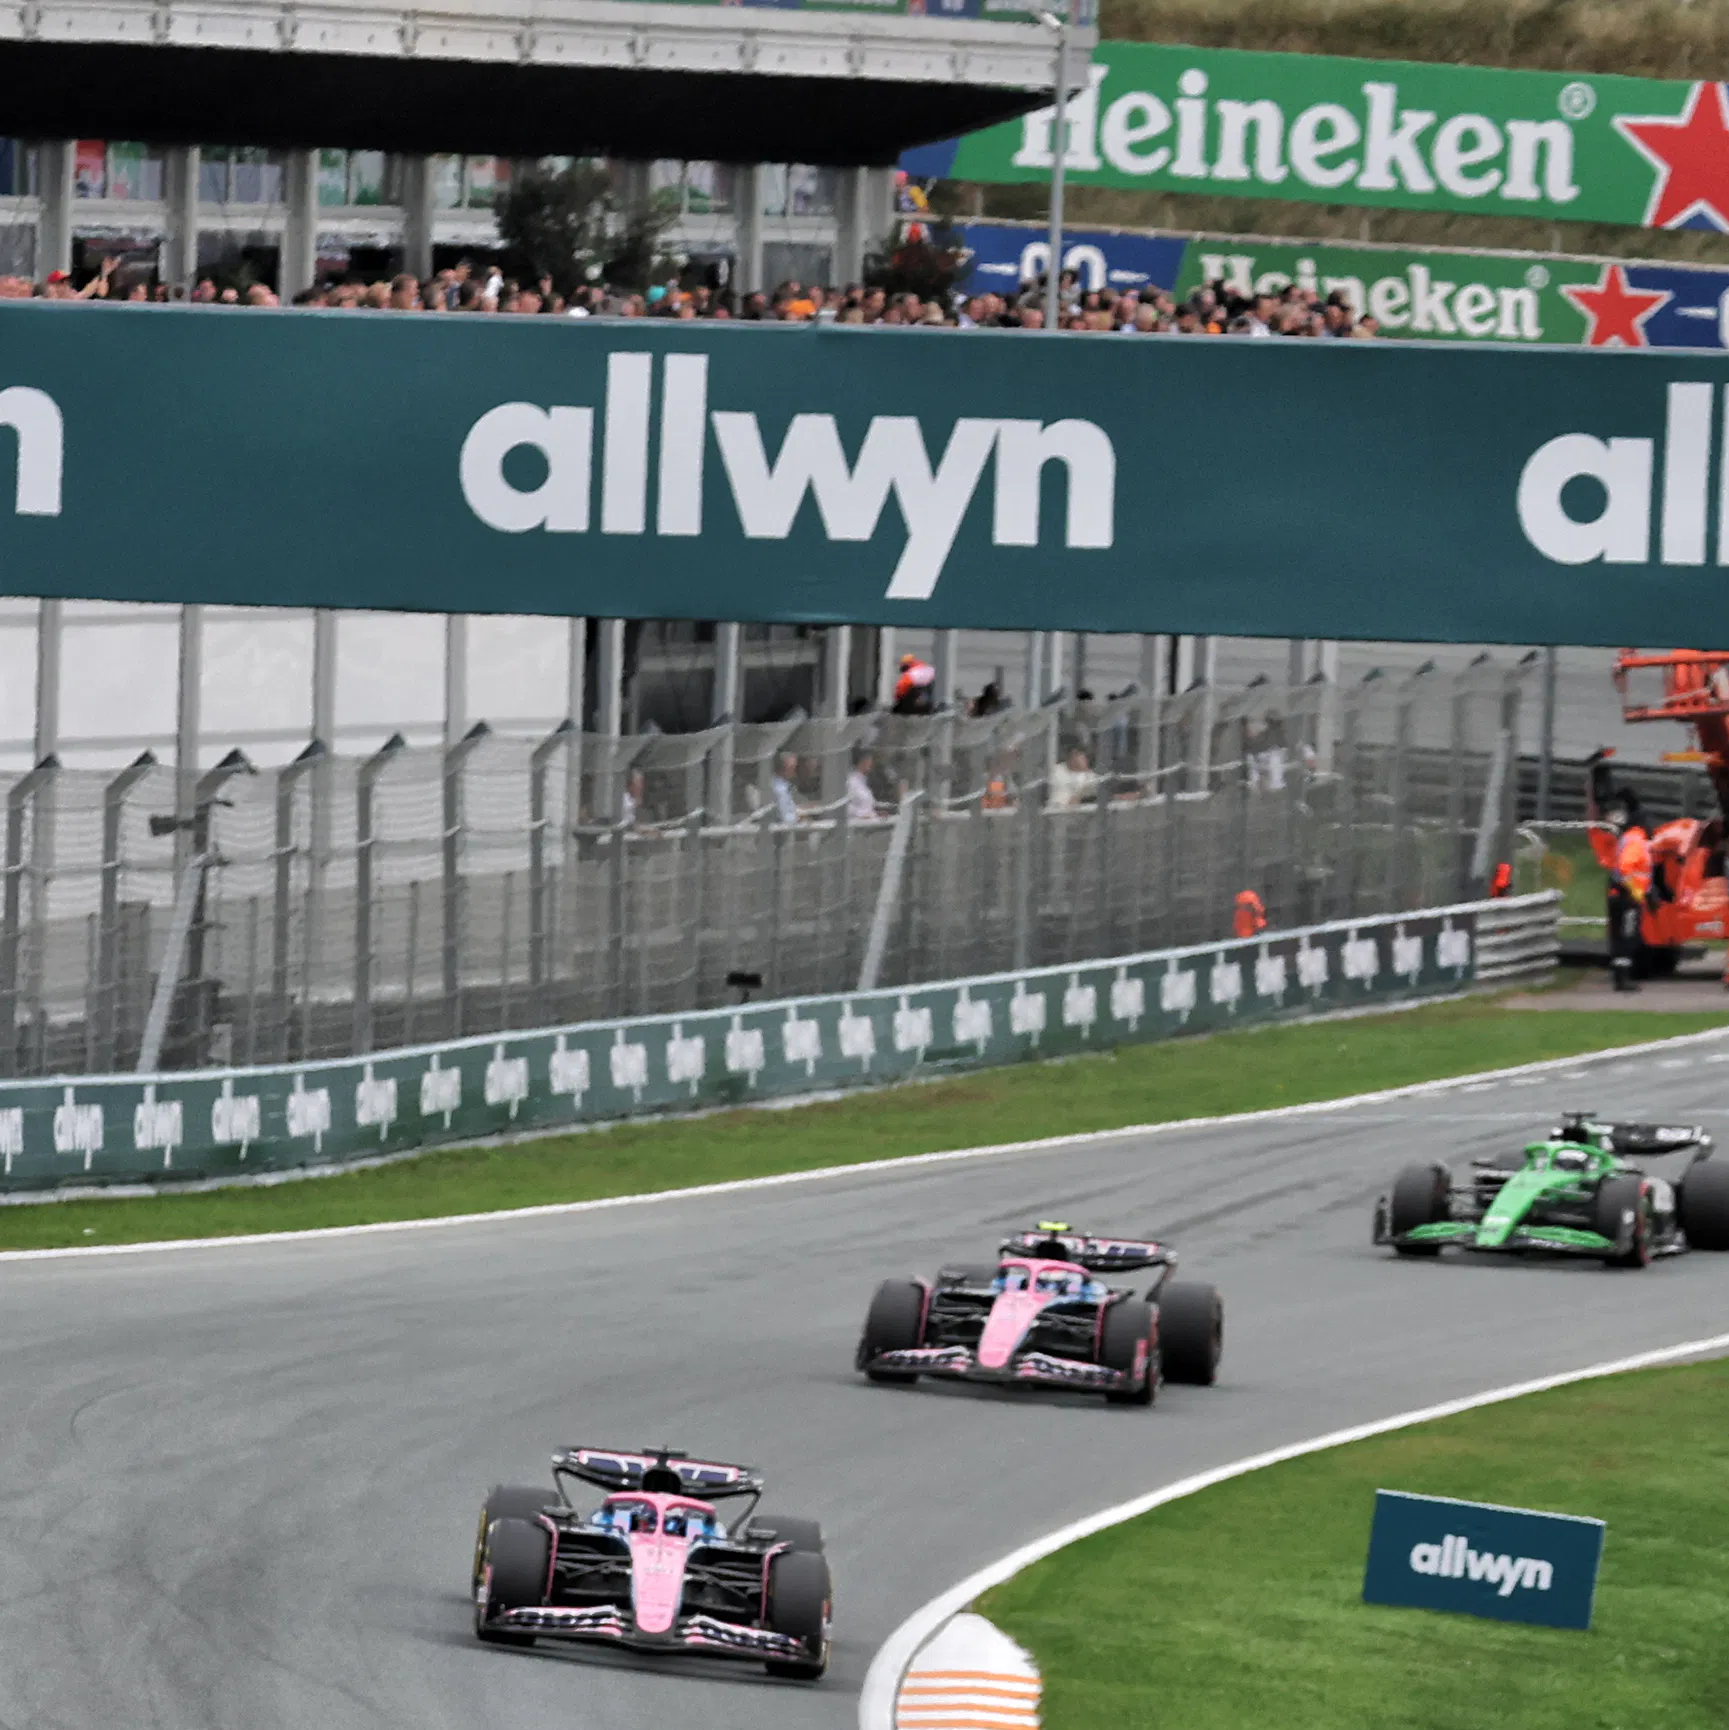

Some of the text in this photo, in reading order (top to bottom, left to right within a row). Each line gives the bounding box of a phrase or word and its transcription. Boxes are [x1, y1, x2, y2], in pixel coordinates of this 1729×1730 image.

[1012, 64, 1580, 202] Heineken
[459, 352, 1115, 600] allwyn
[1410, 1534, 1554, 1597] allwyn
